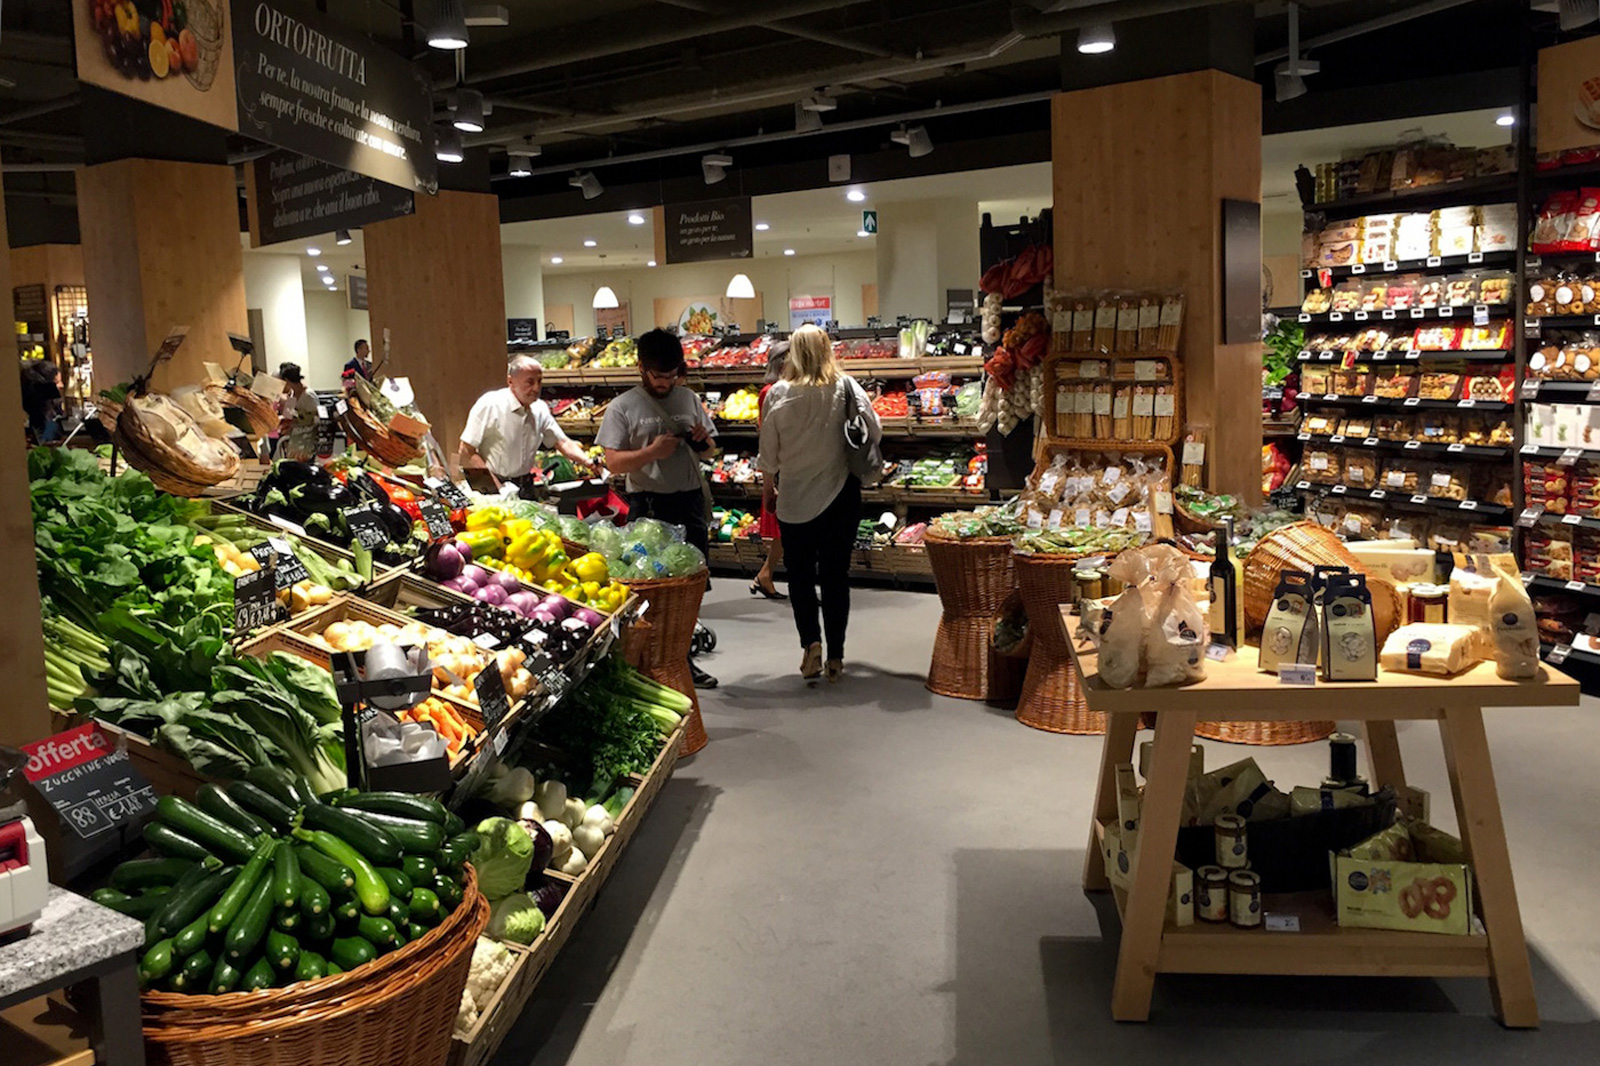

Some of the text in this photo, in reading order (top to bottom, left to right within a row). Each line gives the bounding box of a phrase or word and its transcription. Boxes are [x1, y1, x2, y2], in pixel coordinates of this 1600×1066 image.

[255, 3, 367, 86] ORTOFRUTTA
[257, 53, 276, 79] Per
[290, 68, 301, 90] la
[301, 80, 330, 105] nostra
[329, 87, 355, 113] frutta
[361, 100, 370, 120] la
[370, 107, 394, 131] nostra
[259, 90, 296, 119] sempre
[294, 98, 327, 129] fresche
[334, 118, 368, 146] coltivate
[680, 210, 725, 224] Prodotti Bio
[27, 732, 107, 773] offerta
[71, 806, 97, 829] 88
